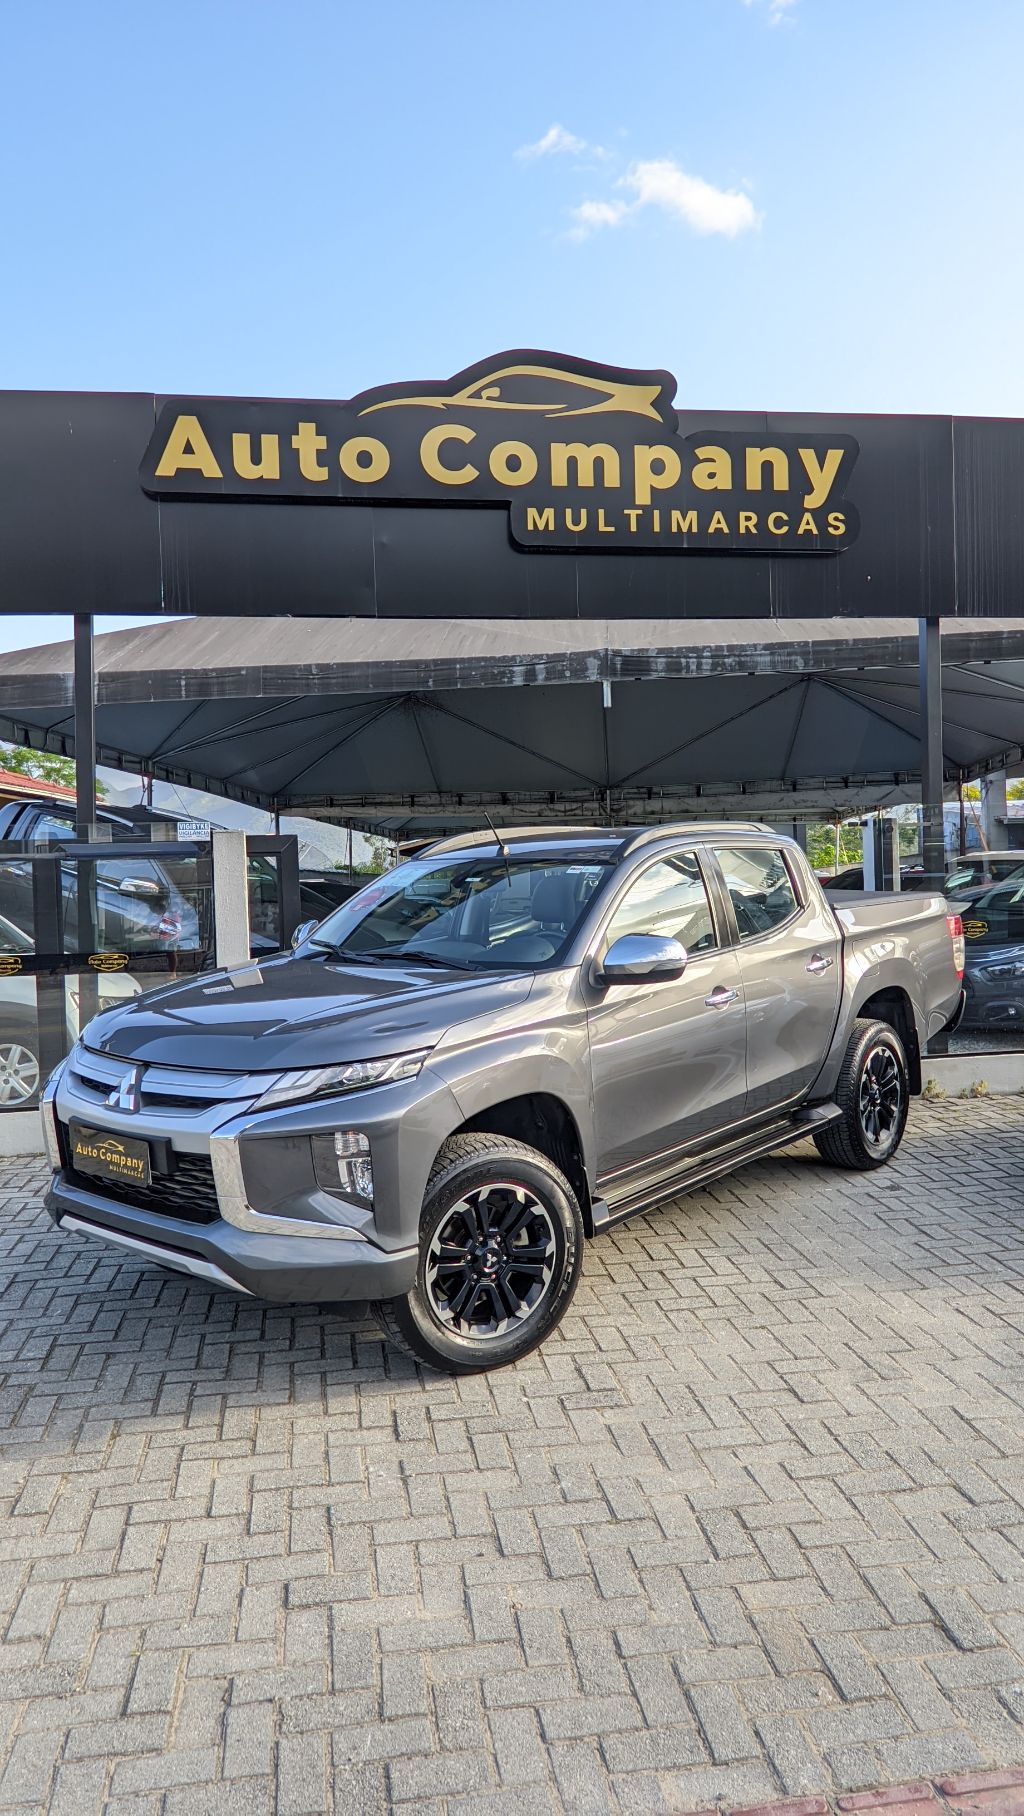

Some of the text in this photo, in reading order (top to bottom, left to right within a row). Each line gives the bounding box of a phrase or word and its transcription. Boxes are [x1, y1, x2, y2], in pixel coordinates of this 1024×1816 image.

[155, 415, 844, 509] Auto Company
[527, 507, 846, 535] MULTIMARCAS
[76, 1143, 144, 1171] Auto Company
[109, 1165, 144, 1178] MULTIMARCAS
